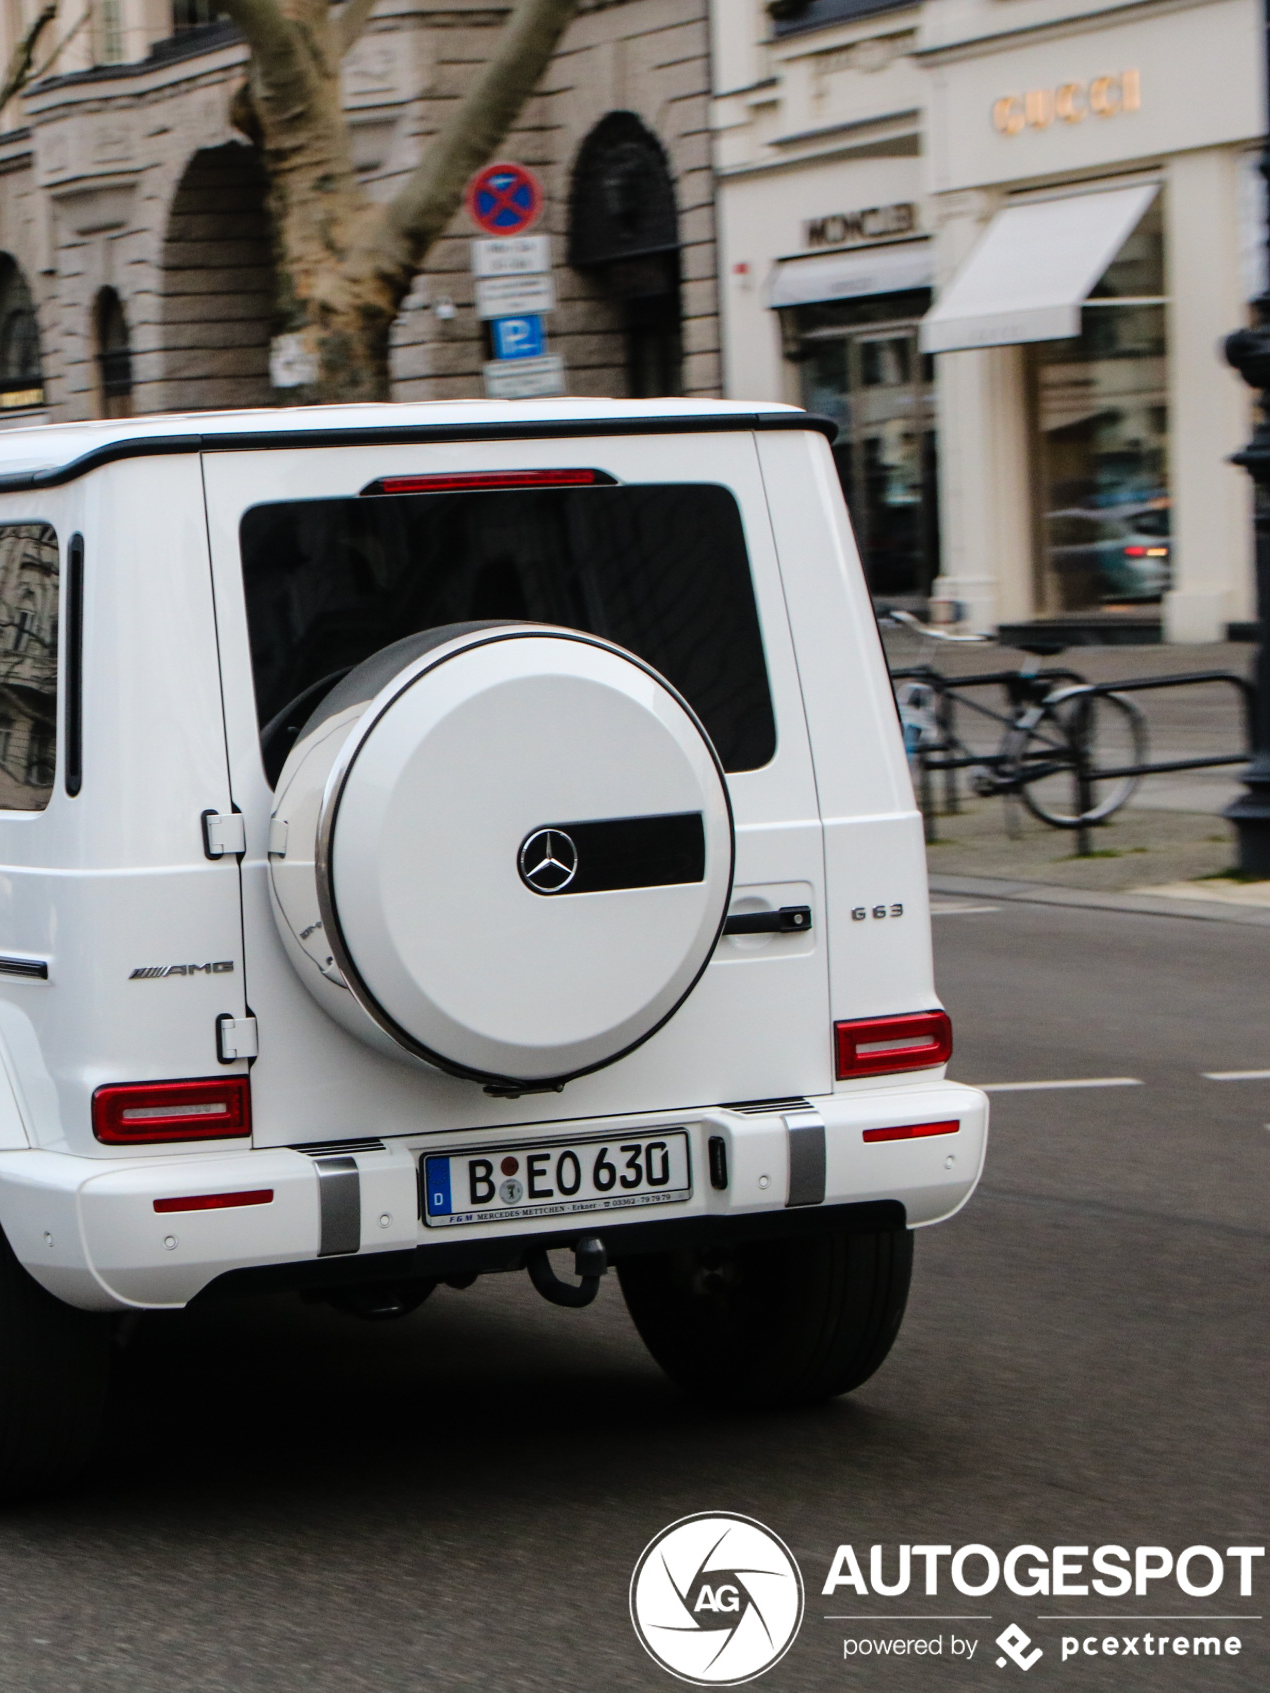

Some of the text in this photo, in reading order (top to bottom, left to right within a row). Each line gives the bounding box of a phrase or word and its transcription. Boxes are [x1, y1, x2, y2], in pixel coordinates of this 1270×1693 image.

[993, 69, 1141, 135] GUCCI
[433, 1192, 444, 1206] D
[468, 1141, 670, 1205] B EO 630
